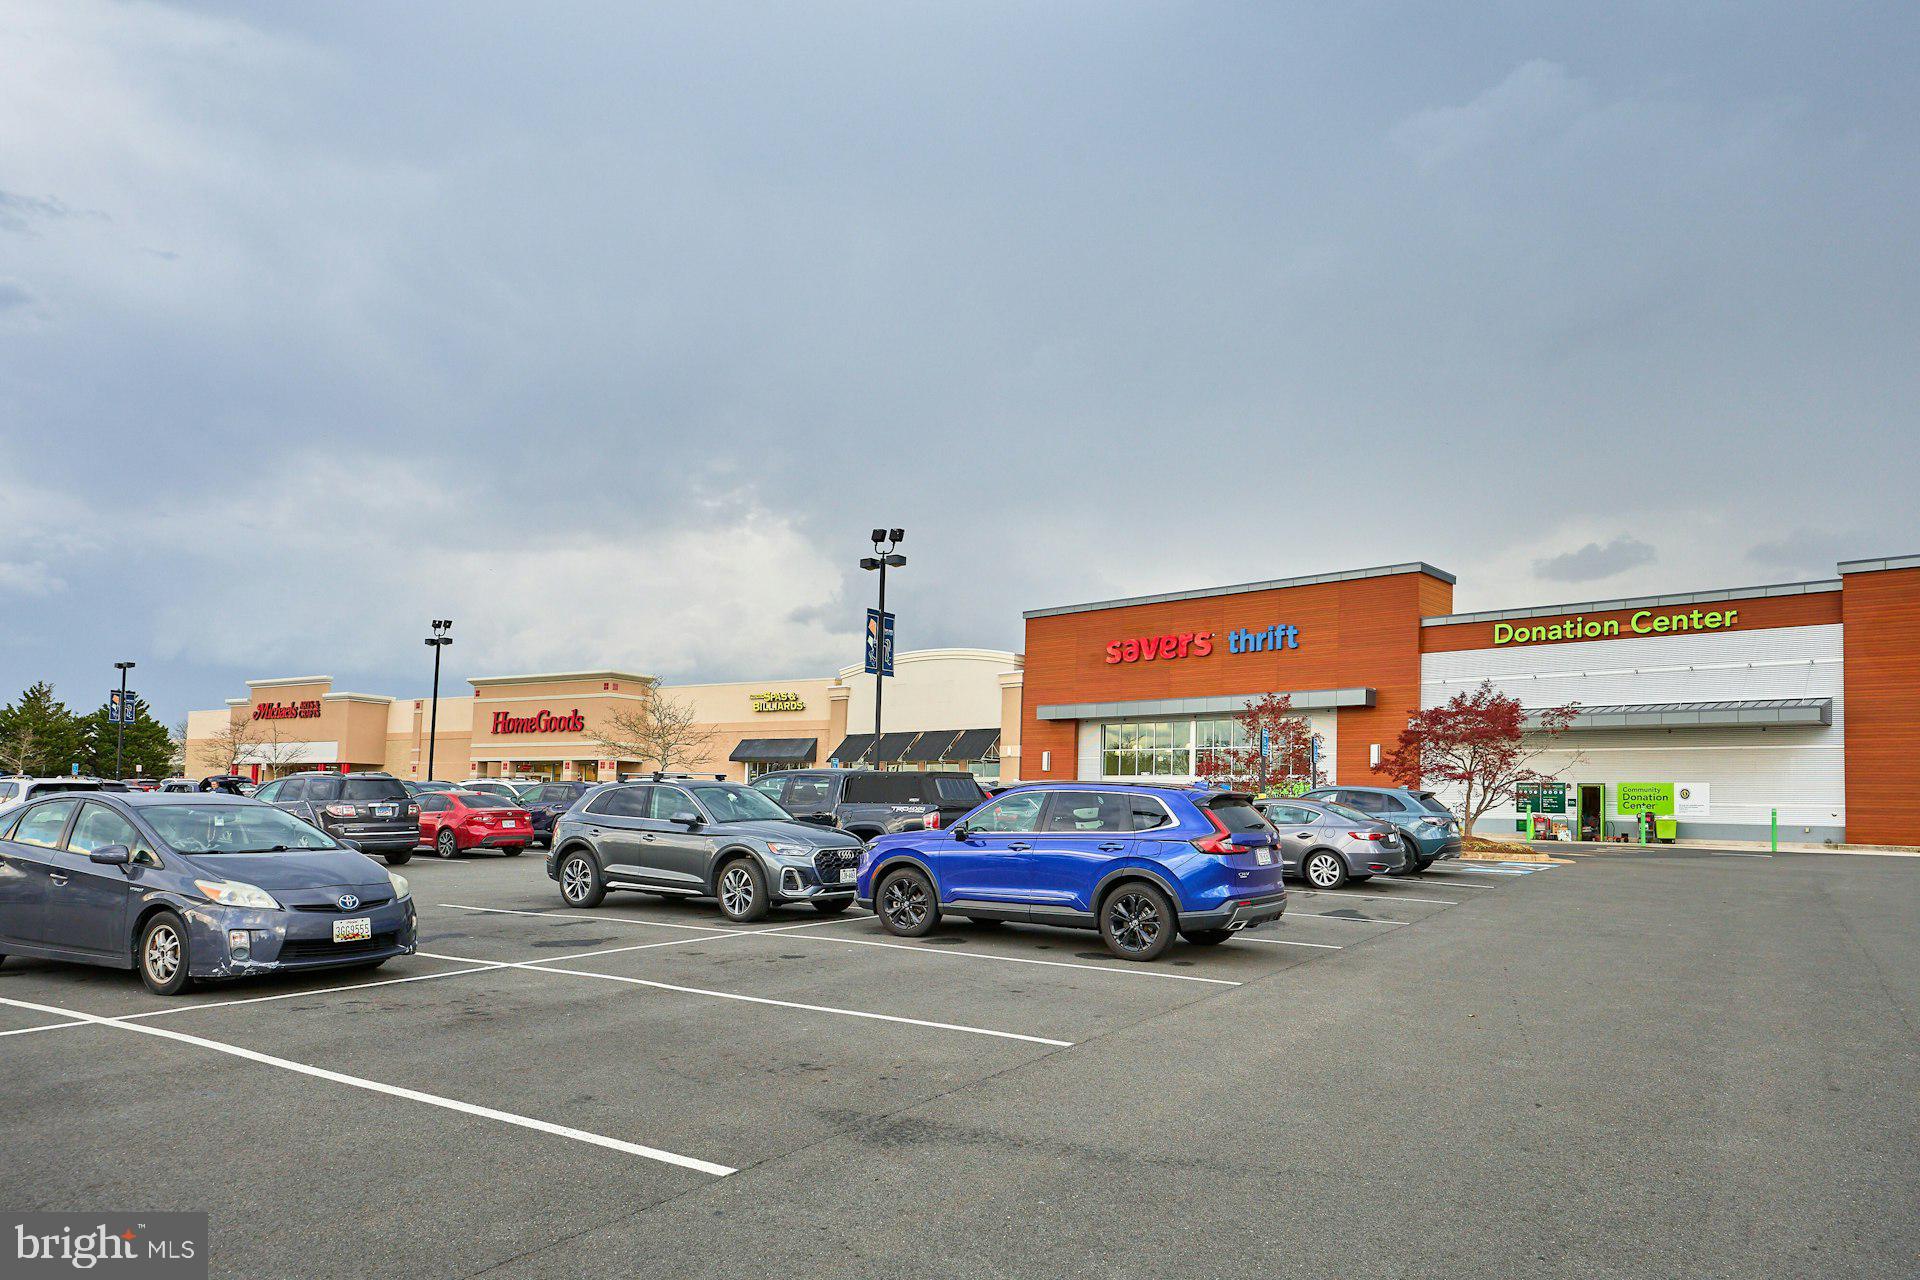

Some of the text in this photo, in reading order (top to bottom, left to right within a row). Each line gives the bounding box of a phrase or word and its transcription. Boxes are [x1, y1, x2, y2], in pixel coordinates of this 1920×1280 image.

[1493, 609, 1738, 645] Donation Center
[1105, 624, 1299, 664] savers thrift
[763, 691, 788, 702] SPAS
[789, 691, 798, 701] &
[253, 702, 298, 720] Michaels
[753, 701, 805, 712] BILLIARDS
[491, 708, 585, 734] HomeGoods
[1622, 786, 1661, 794] Community
[1622, 793, 1669, 801] Donation
[1622, 801, 1656, 810] Center
